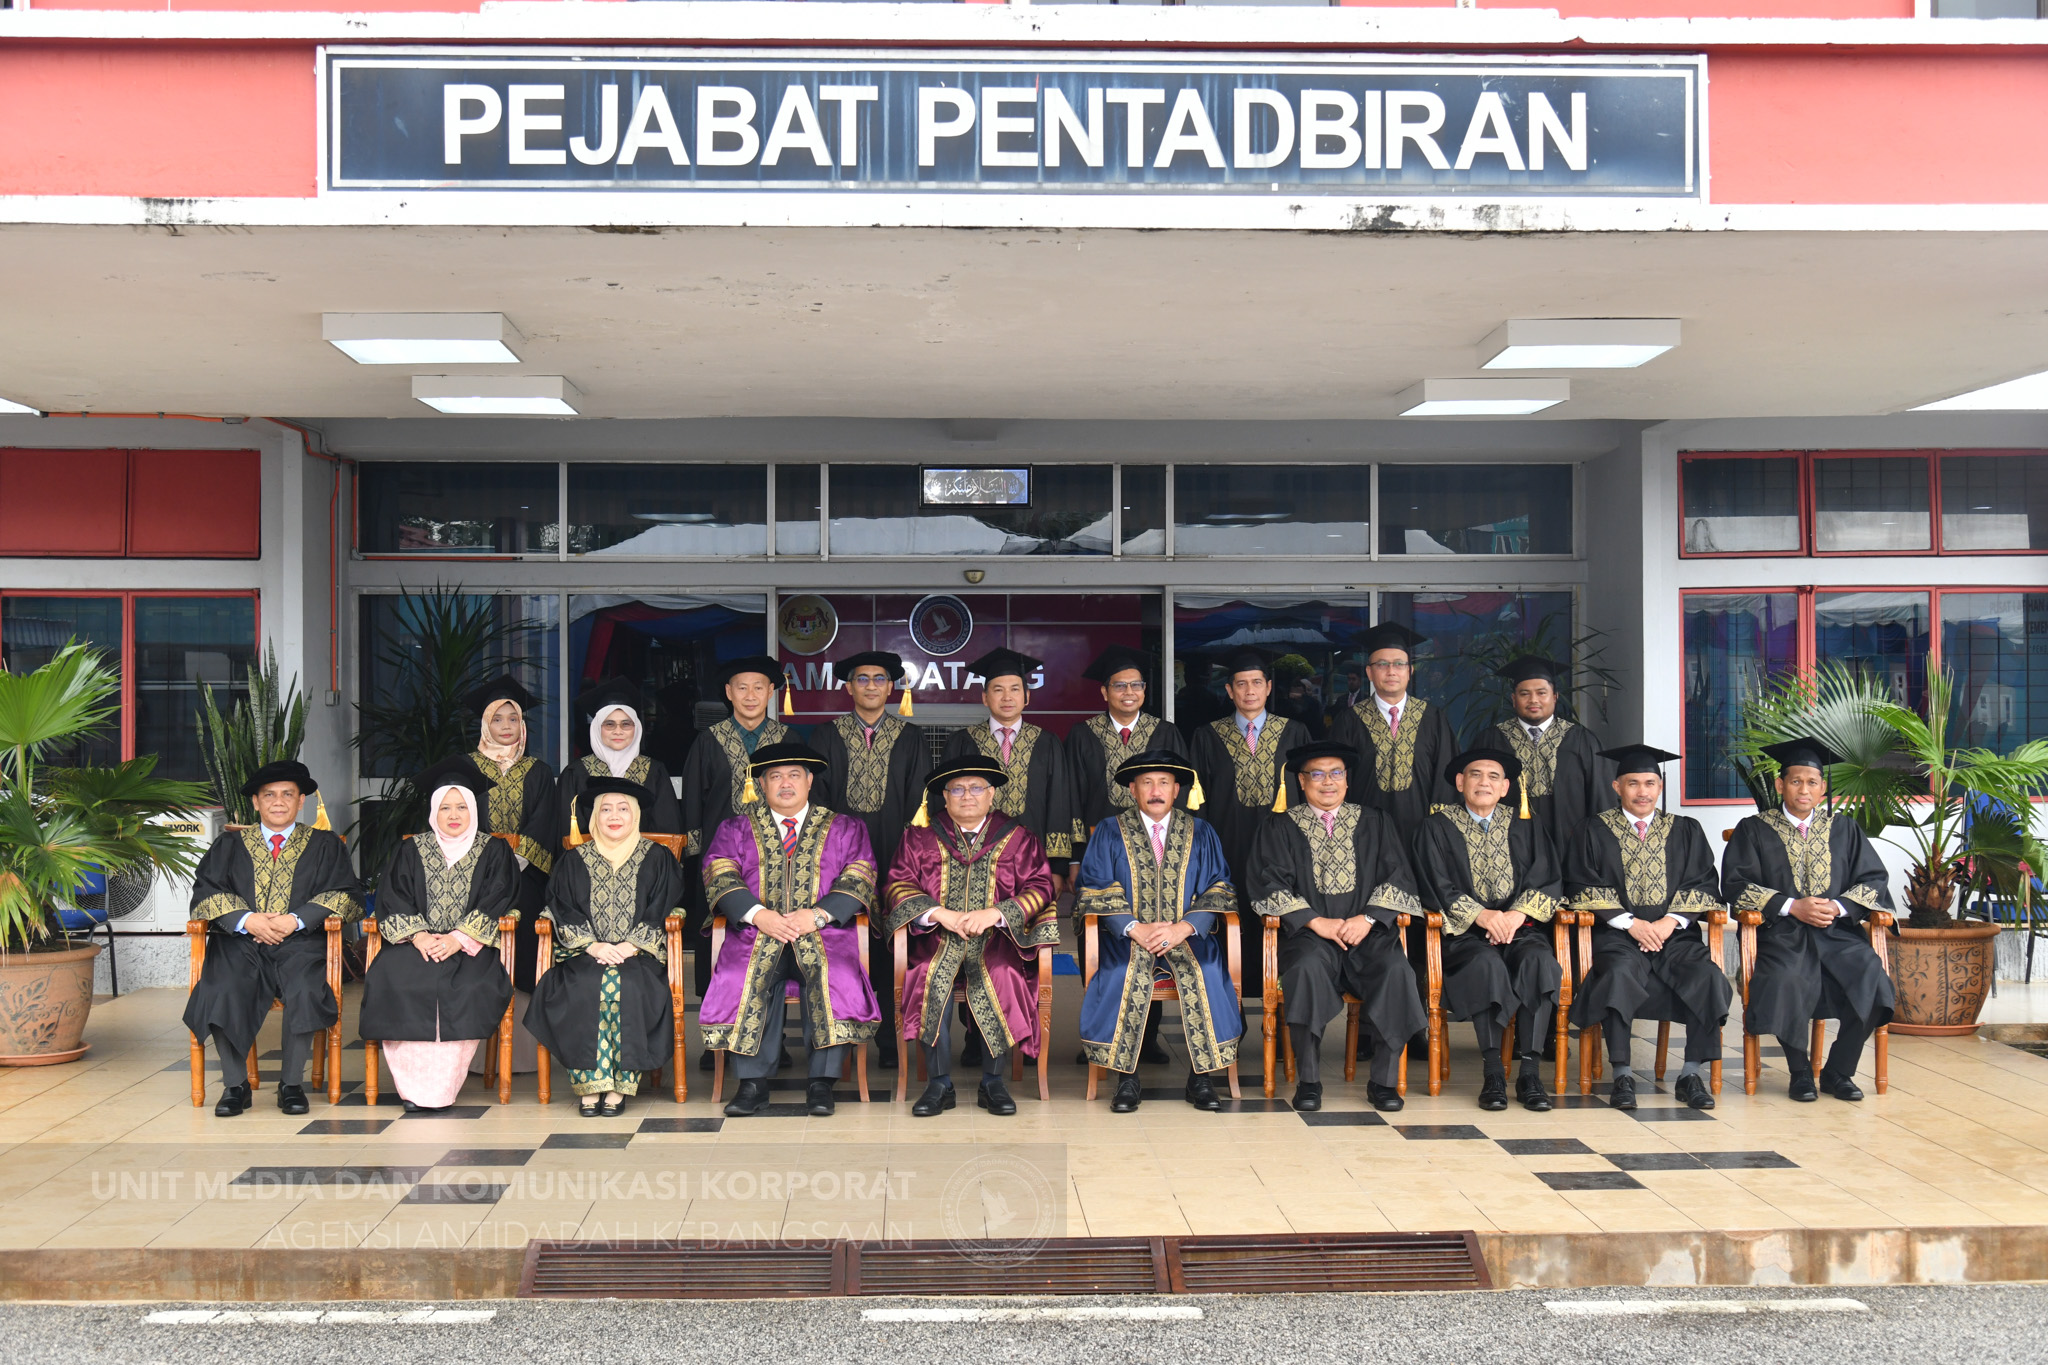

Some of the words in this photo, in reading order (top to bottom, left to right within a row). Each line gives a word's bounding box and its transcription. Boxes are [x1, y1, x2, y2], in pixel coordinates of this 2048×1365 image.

[443, 84, 879, 167] PEJABAT
[917, 86, 1588, 171] PENTADBIRAN
[894, 661, 1045, 690] DATAG
[174, 823, 200, 833] YORK
